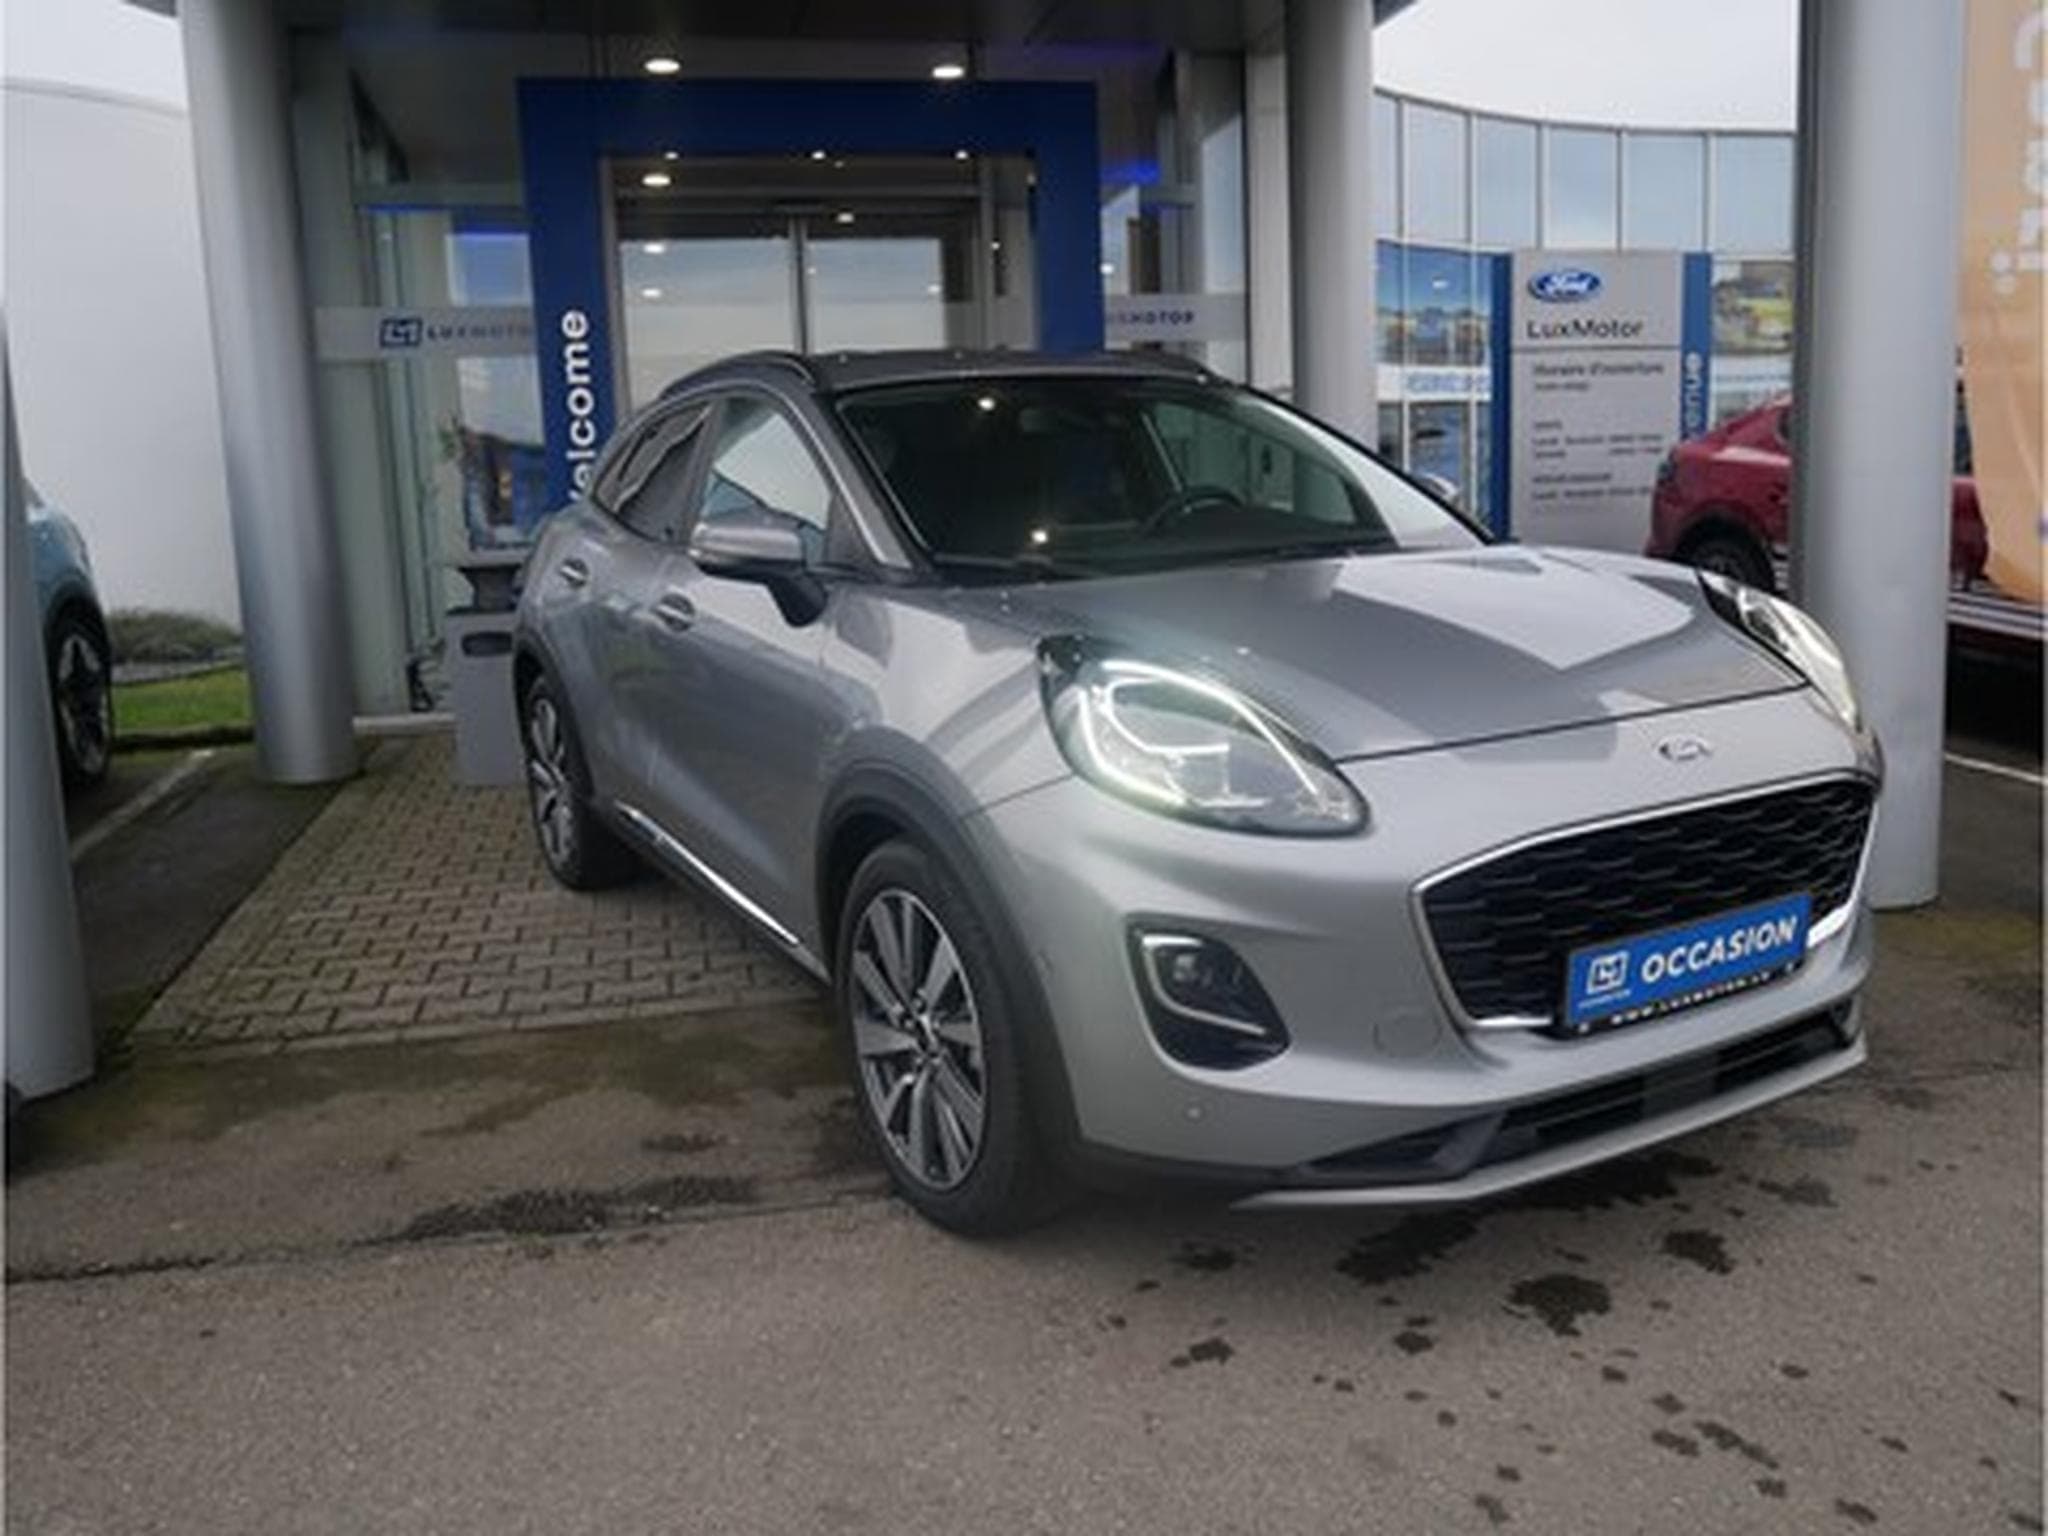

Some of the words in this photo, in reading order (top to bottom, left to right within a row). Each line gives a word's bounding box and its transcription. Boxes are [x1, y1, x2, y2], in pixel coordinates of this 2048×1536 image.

[1526, 318, 1644, 340] LuxMotor
[558, 309, 599, 500] elcome
[1640, 916, 1798, 984] OCCASION
